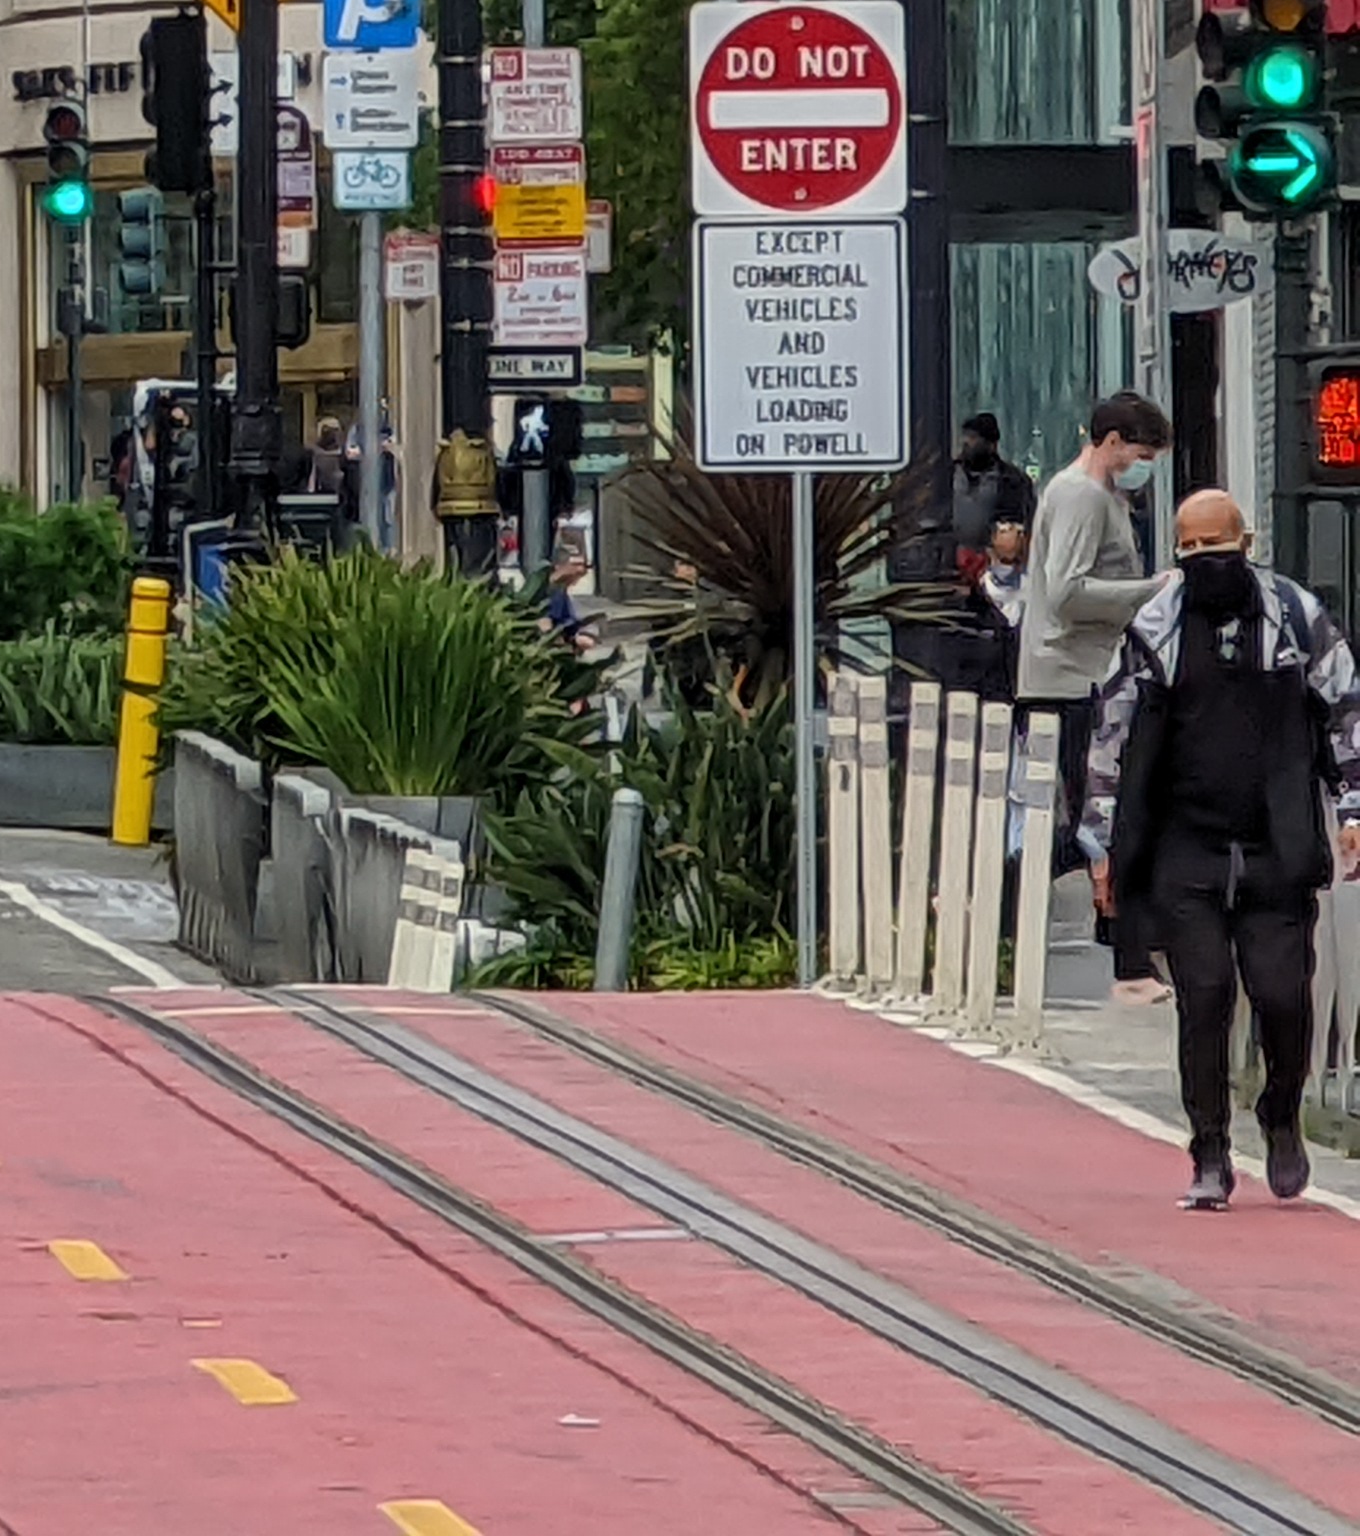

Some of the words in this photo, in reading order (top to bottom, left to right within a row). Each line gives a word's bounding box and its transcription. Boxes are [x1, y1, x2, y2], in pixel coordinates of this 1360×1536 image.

[726, 46, 776, 80] DO
[798, 44, 871, 78] NOT
[740, 138, 858, 172] ENTER
[756, 230, 844, 255] EXCEPT
[733, 264, 869, 289] COMMERCIAL
[745, 297, 858, 322] VEHICLES
[777, 331, 825, 355] AND
[531, 358, 567, 373] WAY
[745, 365, 858, 390] VEHICLES
[756, 399, 848, 423] LOADING
[736, 432, 765, 457] ON
[784, 432, 869, 456] POWELL
